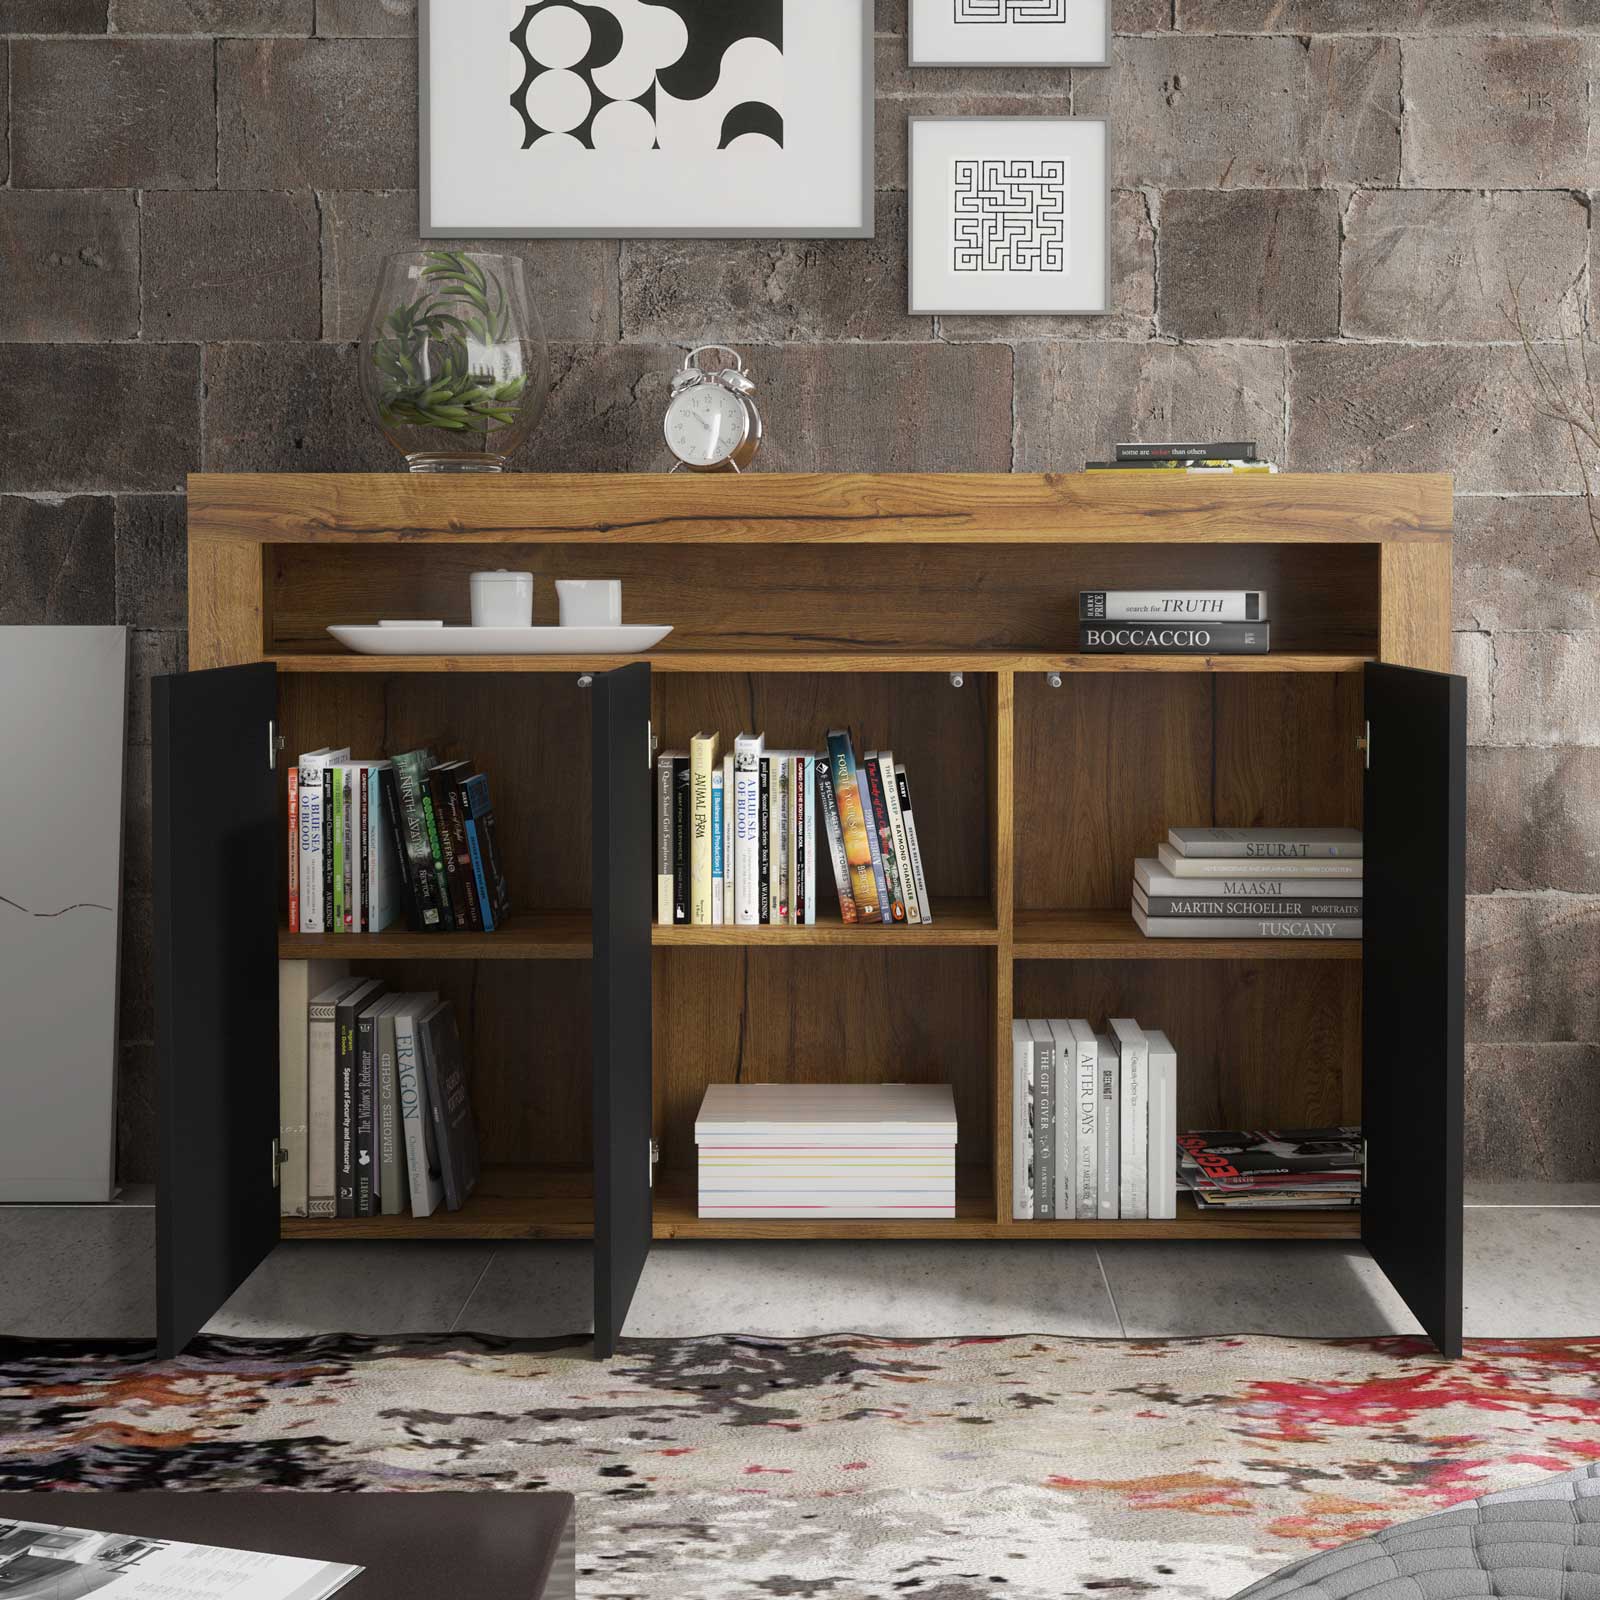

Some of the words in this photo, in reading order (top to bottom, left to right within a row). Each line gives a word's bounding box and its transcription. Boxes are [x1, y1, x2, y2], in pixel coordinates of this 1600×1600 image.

[1095, 594, 1104, 616] PRICE
[1126, 605, 1148, 613] search
[1150, 604, 1160, 613] for
[1162, 599, 1223, 613] TRUTH
[1087, 630, 1211, 646] BOCCACCIO
[779, 763, 787, 778] Viking
[836, 754, 851, 791] FORTIFY
[868, 762, 876, 776] The
[400, 775, 417, 813] NINTH
[662, 771, 670, 794] Quaker
[695, 772, 706, 810] ANIMAL
[737, 781, 746, 797] OF
[747, 779, 756, 787] A
[870, 778, 880, 797] Lady
[301, 795, 309, 812] OF
[662, 796, 671, 817] School
[747, 790, 756, 819] BLUE
[843, 793, 857, 820] YOUR
[873, 798, 882, 806] of
[876, 807, 884, 819] the
[311, 804, 319, 831] BLUE
[662, 818, 671, 831] Girl
[695, 814, 707, 838] FARM
[737, 800, 746, 838] BLOOD
[301, 814, 309, 850] BLOOD
[747, 822, 756, 840] SEA
[825, 781, 835, 809] SPECIAL
[830, 811, 840, 834] AGENT
[835, 837, 843, 854] NICK
[839, 856, 848, 882] TORRES
[884, 765, 892, 779] THE
[890, 796, 898, 815] SLEEP
[895, 824, 907, 861] RAYMOND
[902, 864, 914, 900] CHANDLER
[311, 834, 319, 852] SEA
[441, 830, 456, 873] INFERNO
[662, 834, 671, 861] Samplers
[1246, 843, 1310, 857] SEURAT
[1223, 881, 1283, 895] MAASAI
[1170, 902, 1224, 914] MARTIN
[1226, 902, 1302, 914] SCHOELLER
[1311, 904, 1360, 914] PORTRAITS
[1258, 922, 1337, 937] TUSCANY
[360, 1051, 371, 1086] Redeemer
[1040, 1050, 1049, 1070] THE
[382, 1054, 392, 1099] CACHED
[397, 1034, 419, 1120] ERAGON
[1040, 1073, 1049, 1096] GIFT
[1081, 1054, 1094, 1098] AFTER
[343, 1100, 351, 1126] Security
[359, 1090, 371, 1118] Widow's
[1040, 1099, 1049, 1130] GIVER
[358, 1120, 370, 1134] The
[1081, 1102, 1094, 1134] DAYS
[383, 1104, 393, 1163] MEMORIES
[343, 1140, 351, 1173] Insecurity
